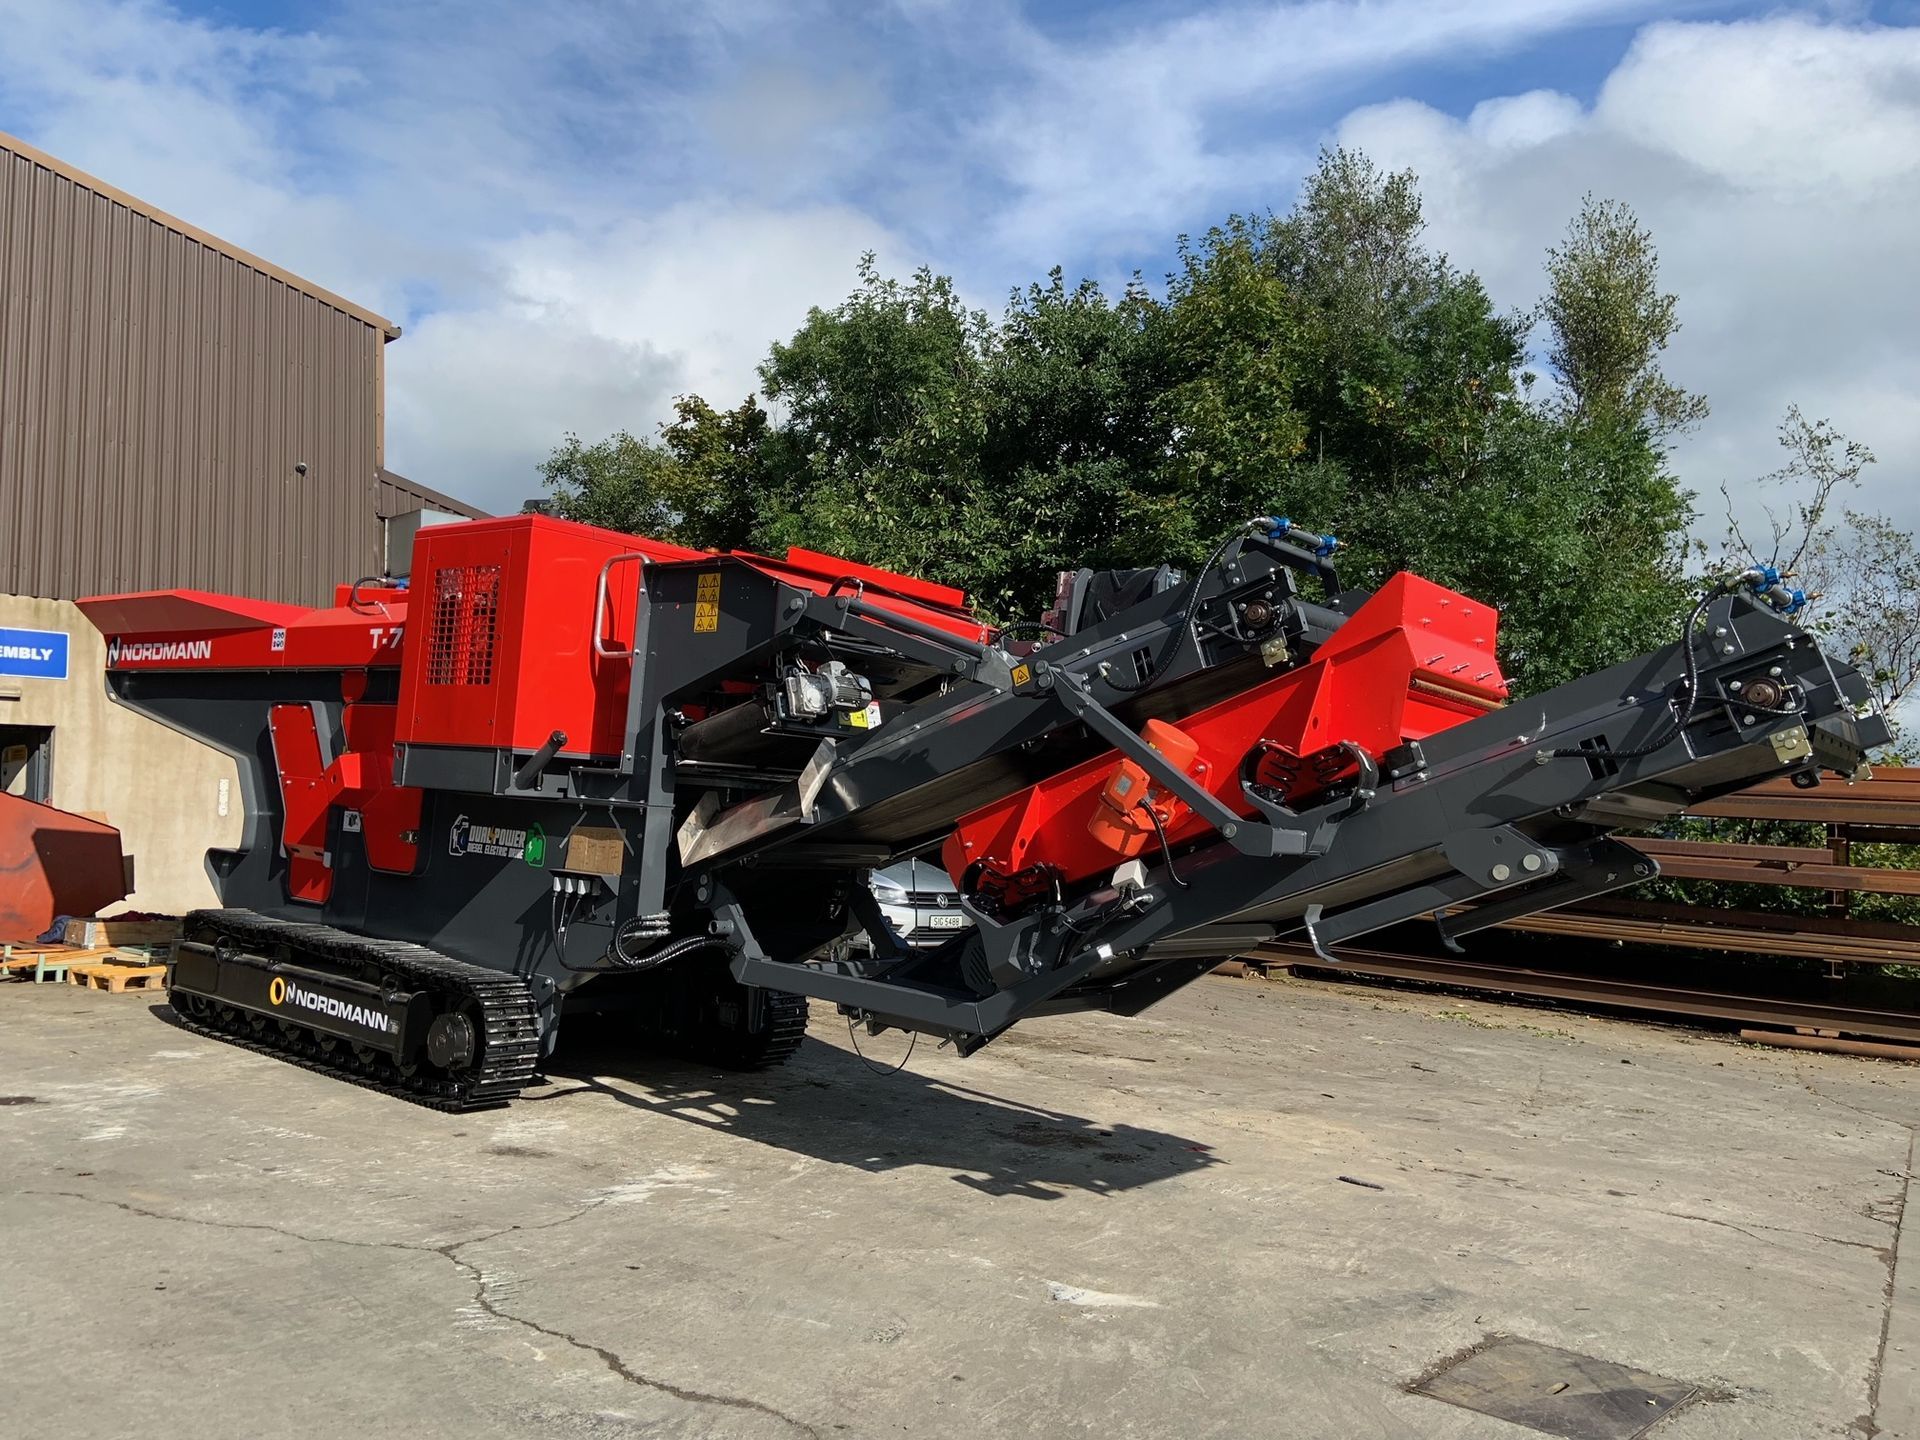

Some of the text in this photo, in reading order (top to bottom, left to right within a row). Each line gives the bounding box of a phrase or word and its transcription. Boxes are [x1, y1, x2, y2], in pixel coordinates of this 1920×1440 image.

[370, 627, 404, 649] T-7
[121, 641, 212, 661] NORDMANN
[469, 825, 526, 848] DUAL POWER
[467, 842, 483, 854] DIESEL
[484, 844, 508, 857] ELECTRIC
[295, 988, 388, 1032] NORDMANN
